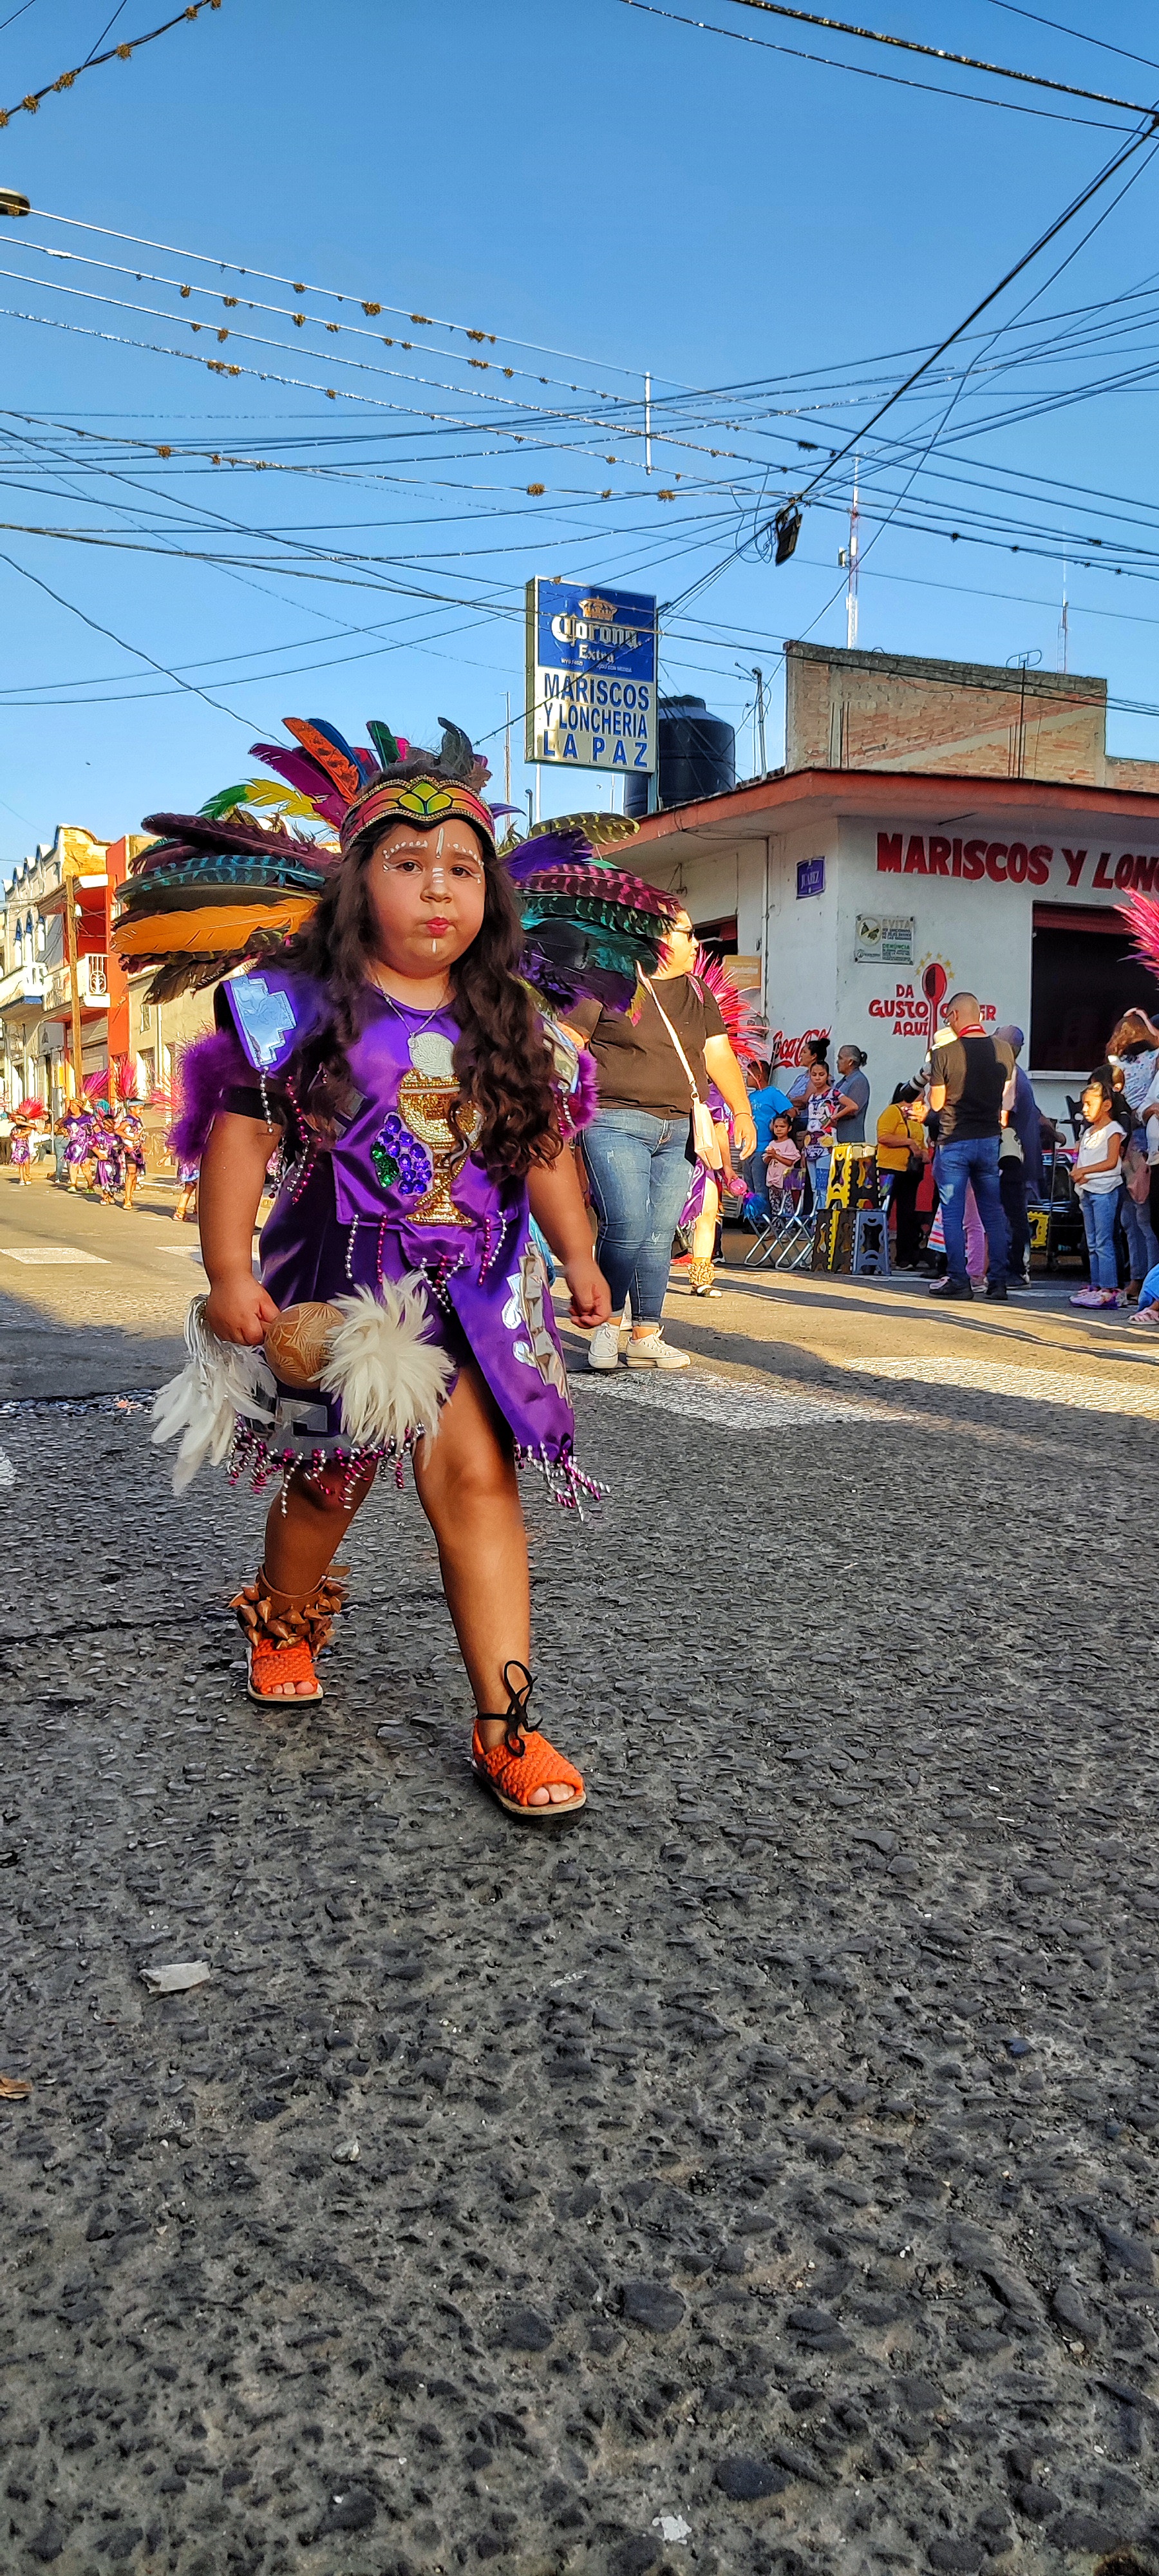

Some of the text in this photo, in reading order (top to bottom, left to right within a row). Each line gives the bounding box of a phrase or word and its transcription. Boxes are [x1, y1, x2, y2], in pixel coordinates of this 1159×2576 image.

[551, 613, 642, 649] Corona
[578, 644, 614, 664] Extra
[545, 673, 649, 712] MARISCOS
[543, 702, 648, 739] Y LONCHERIA
[543, 731, 648, 768] LA PAZ
[877, 832, 1053, 886] MARISCOS
[1061, 848, 1087, 887] Y
[882, 919, 911, 929] EVITA
[896, 984, 914, 999] DA
[869, 999, 928, 1018] GUSTO
[892, 1017, 929, 1038] AQUÍ
